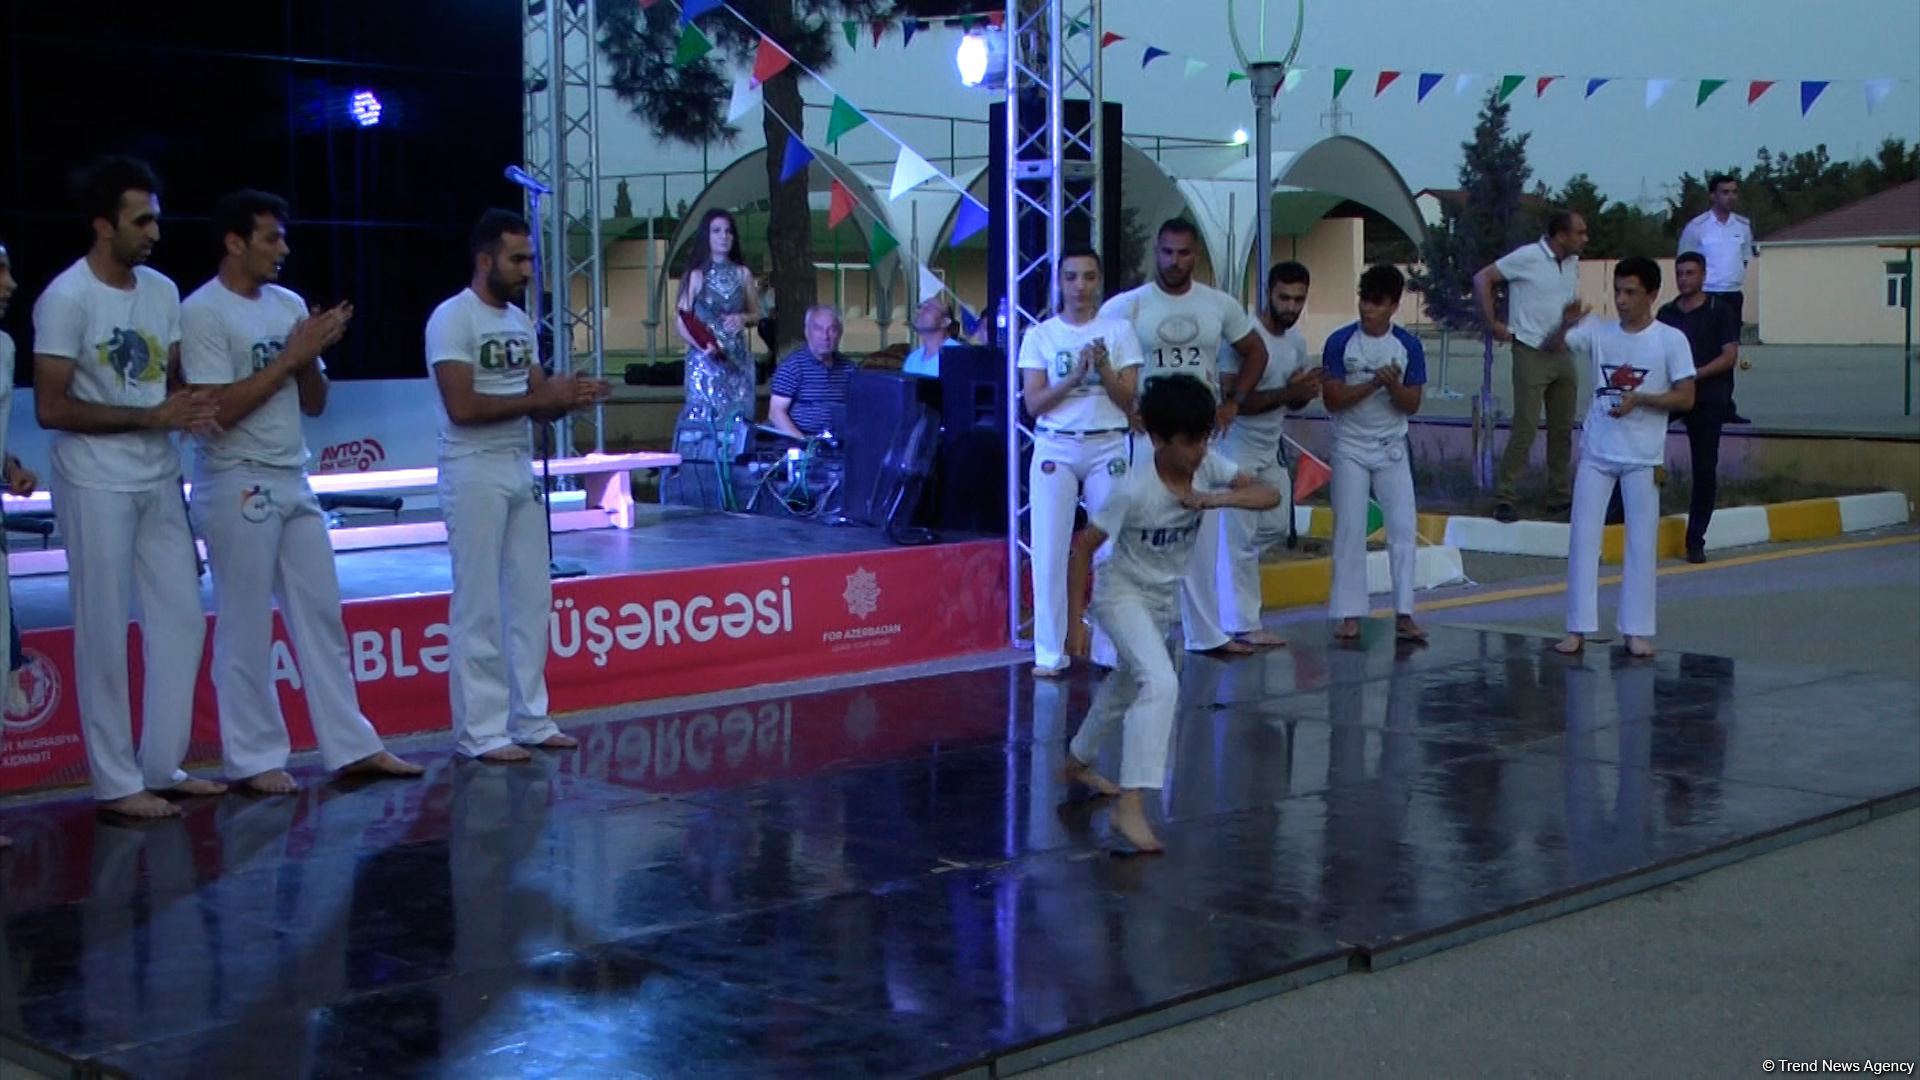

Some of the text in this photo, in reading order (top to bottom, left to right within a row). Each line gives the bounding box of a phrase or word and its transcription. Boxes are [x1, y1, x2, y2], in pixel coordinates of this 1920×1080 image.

[1152, 346, 1201, 368] 132
[321, 441, 361, 461] AVTO
[549, 576, 793, 667] ÜŞƏRGƏSİ
[822, 630, 843, 642] FOR
